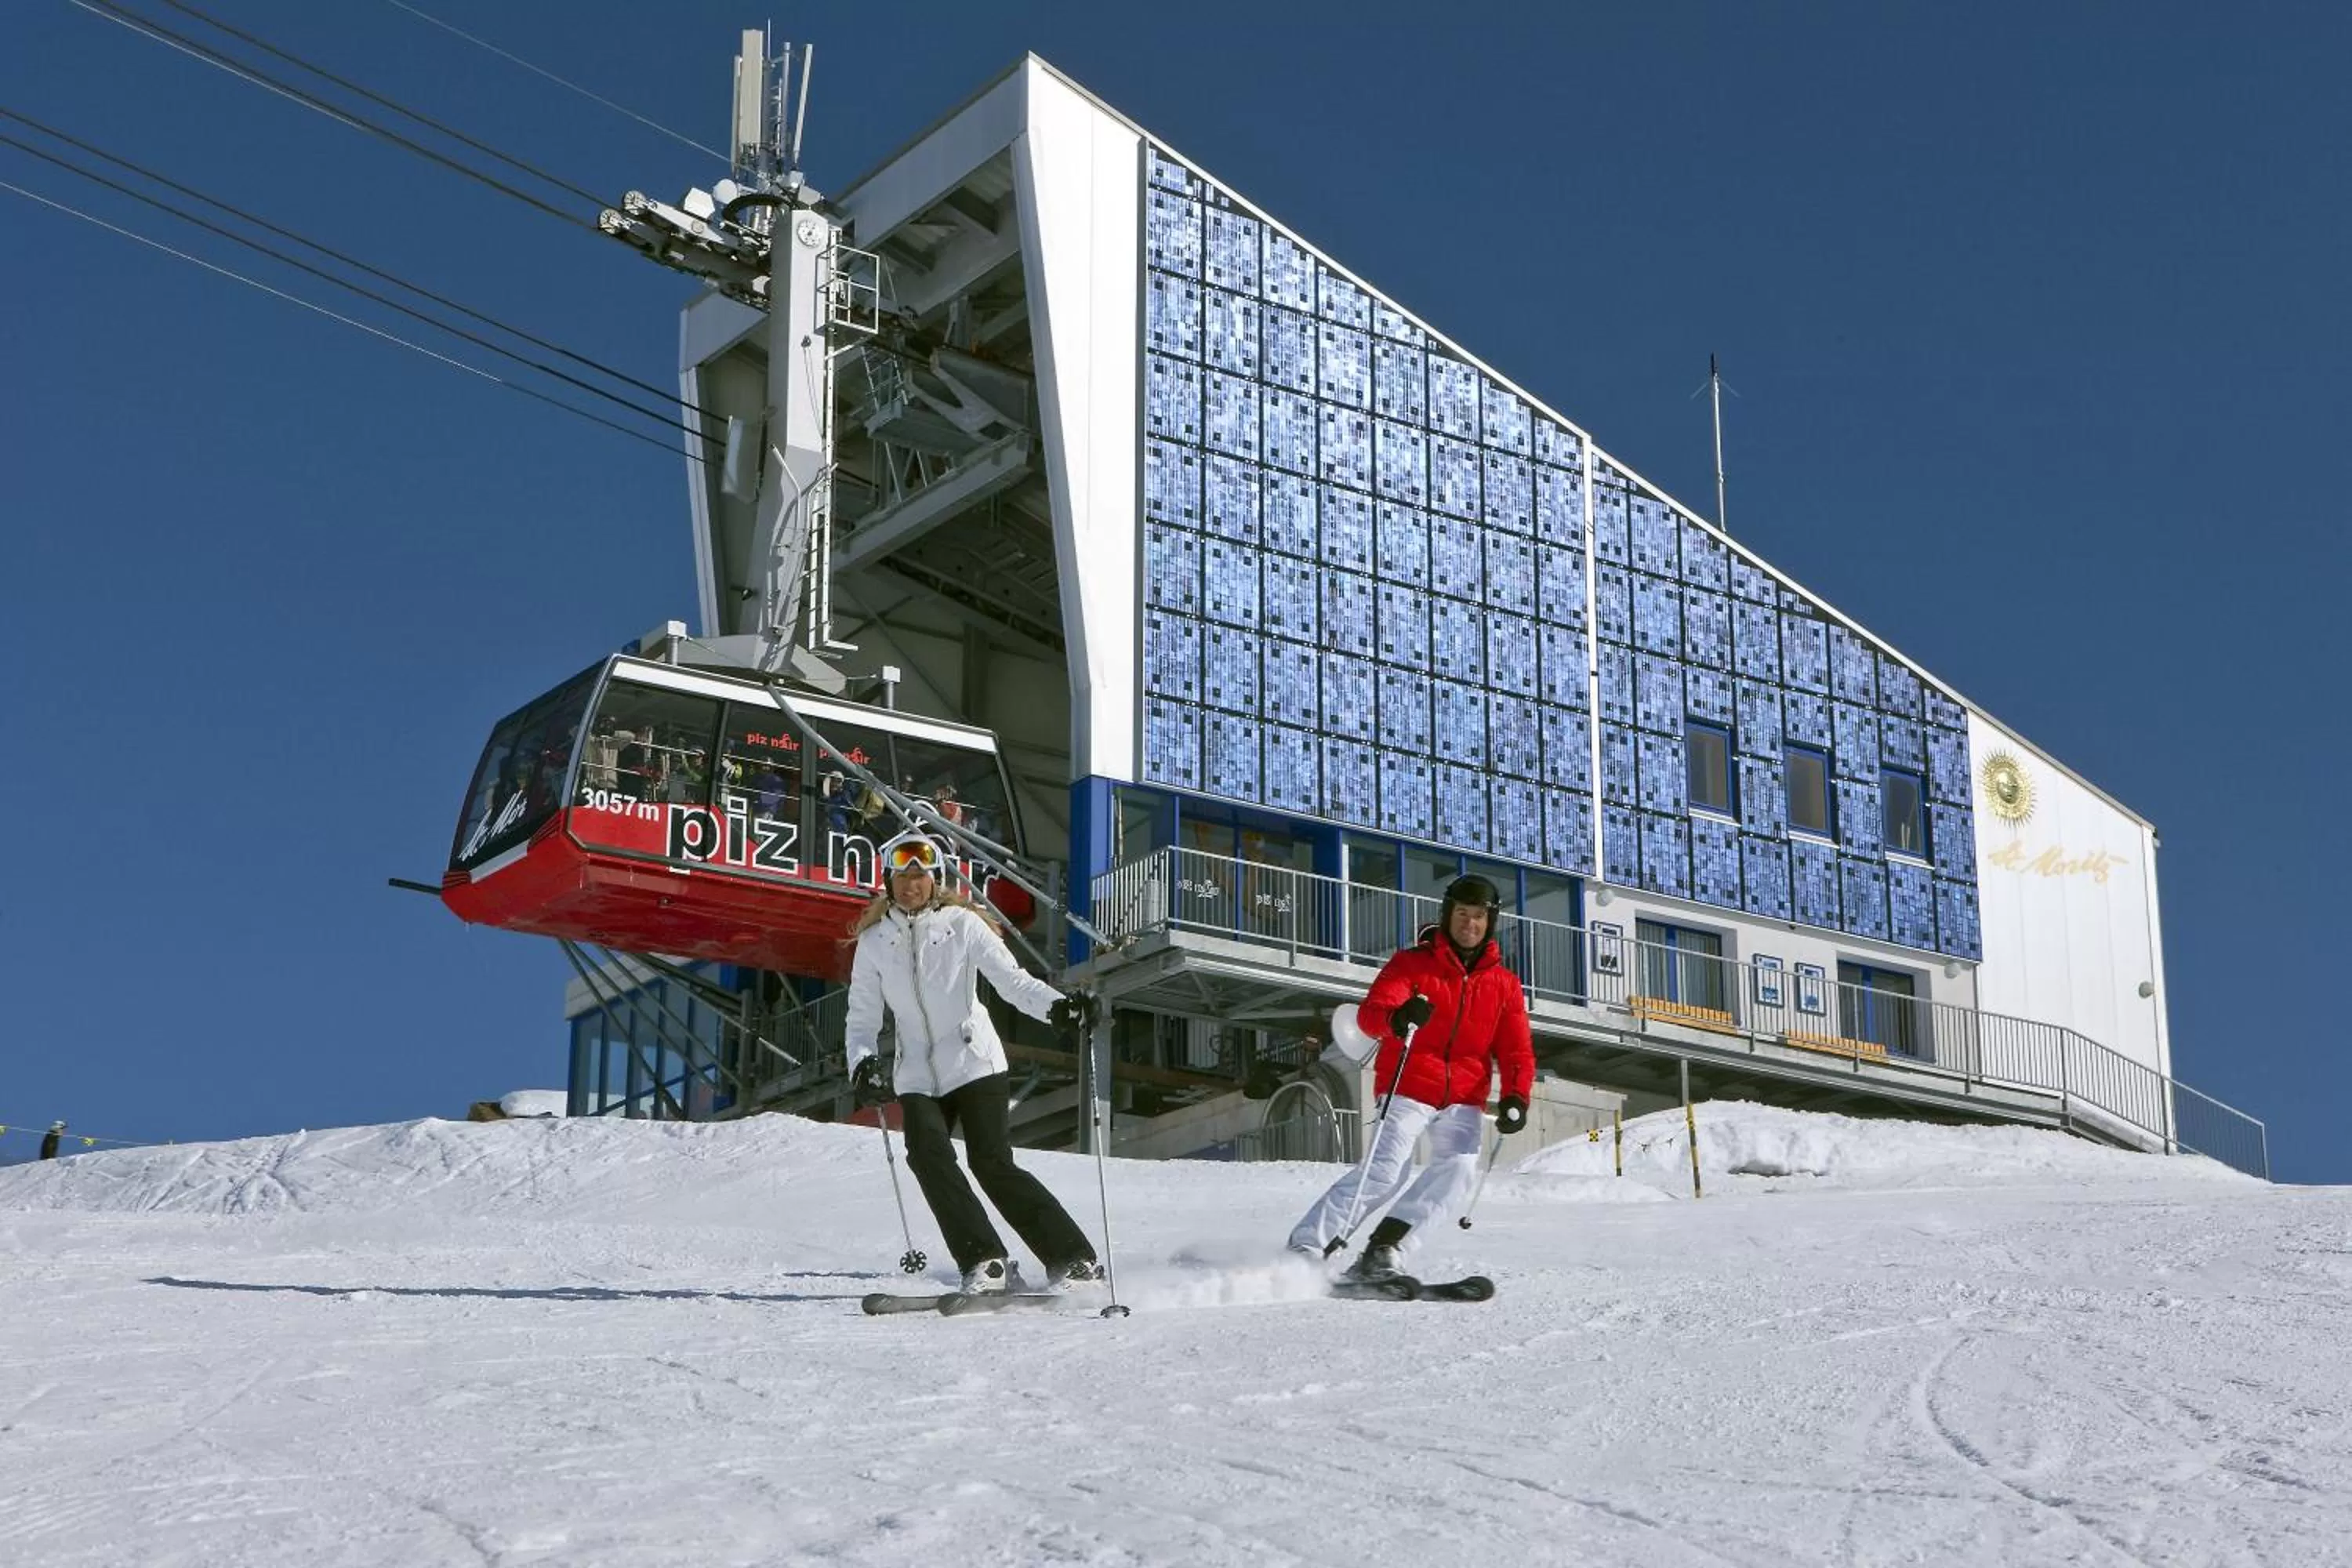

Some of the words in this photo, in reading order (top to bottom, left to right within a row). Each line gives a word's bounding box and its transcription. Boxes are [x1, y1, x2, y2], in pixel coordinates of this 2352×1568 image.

[746, 733, 768, 746] piz
[581, 786, 660, 822] 3057m
[666, 795, 800, 874] piz
